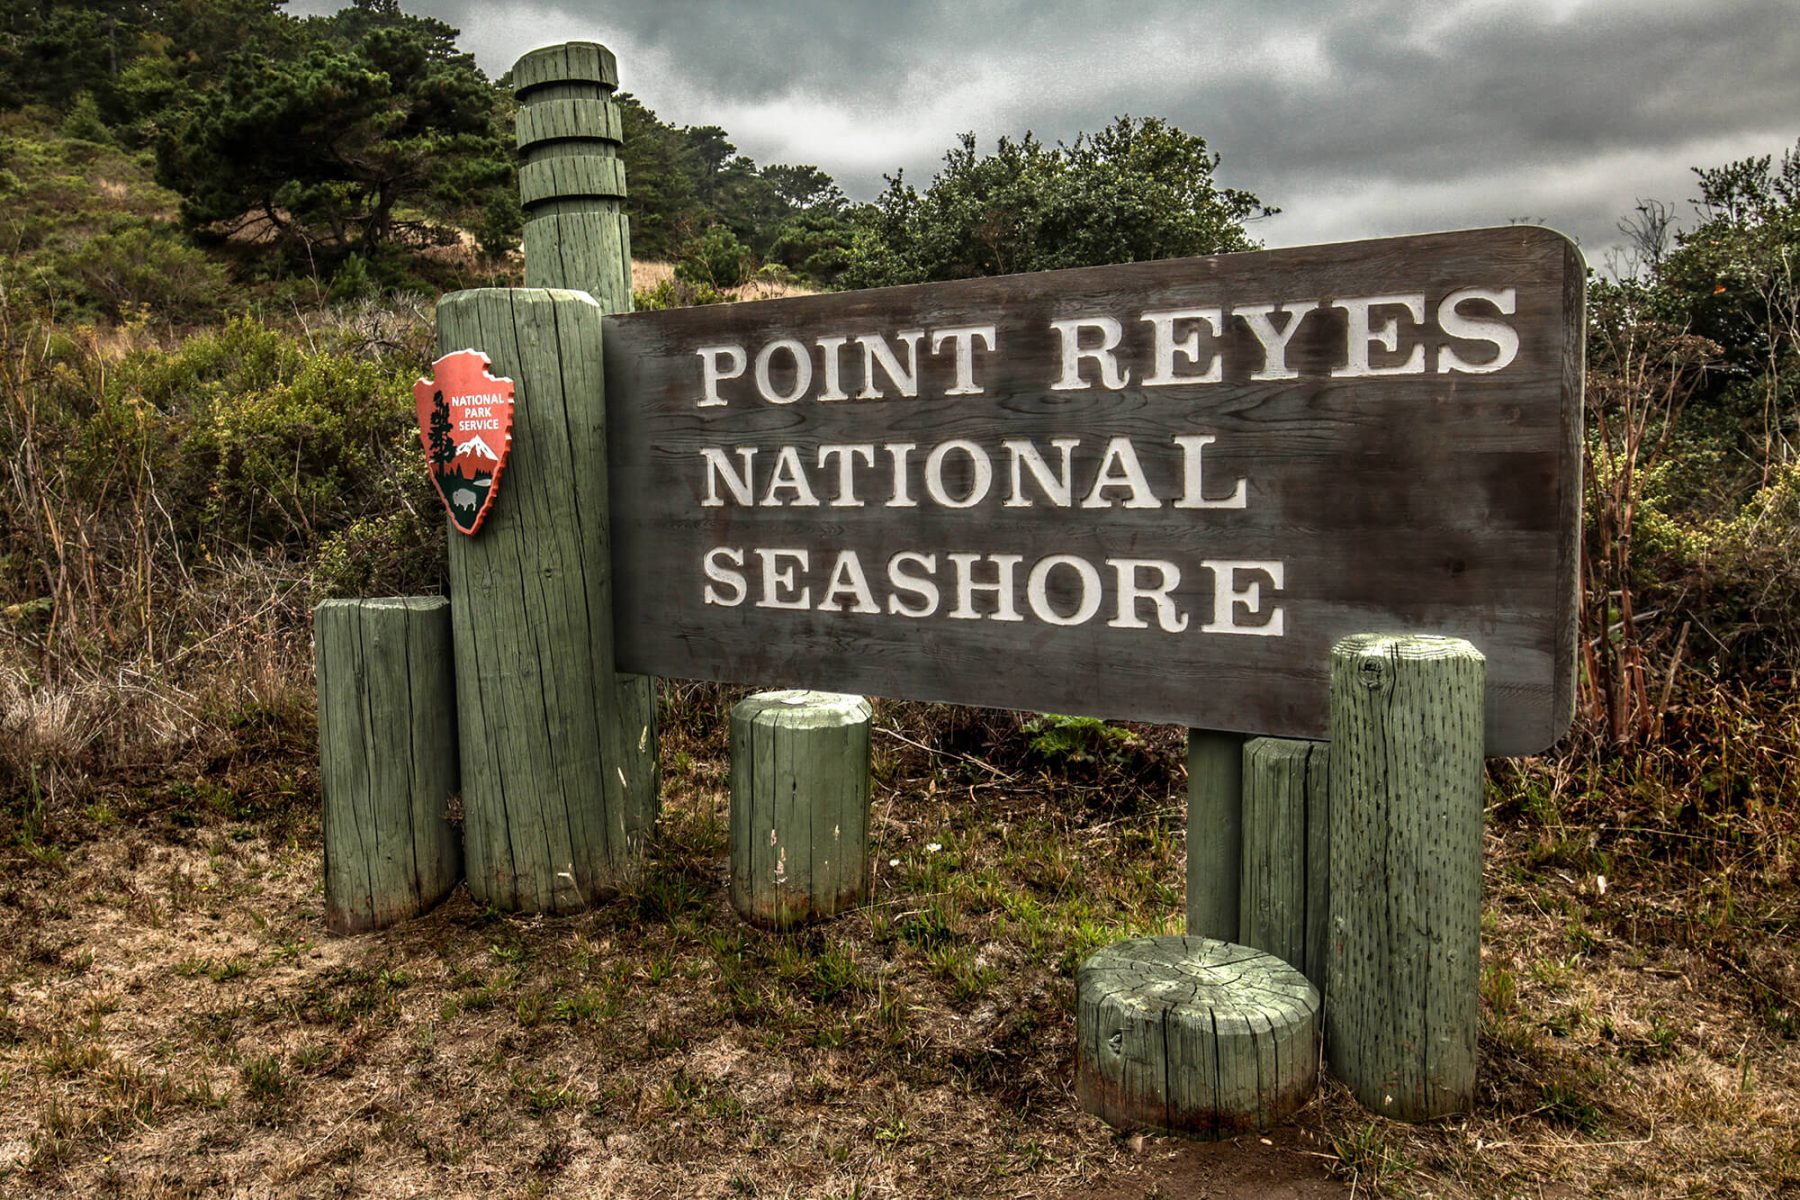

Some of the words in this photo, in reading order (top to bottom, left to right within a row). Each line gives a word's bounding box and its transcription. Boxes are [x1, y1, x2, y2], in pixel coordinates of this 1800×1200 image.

[696, 324, 998, 408] POINT
[1051, 286, 1520, 391] REYES
[451, 393, 505, 407] NATIONAL
[464, 407, 492, 418] PARK
[458, 419, 499, 431] SERVICE
[701, 434, 1248, 510] NATIONAL
[703, 546, 1285, 637] SEASHORE
